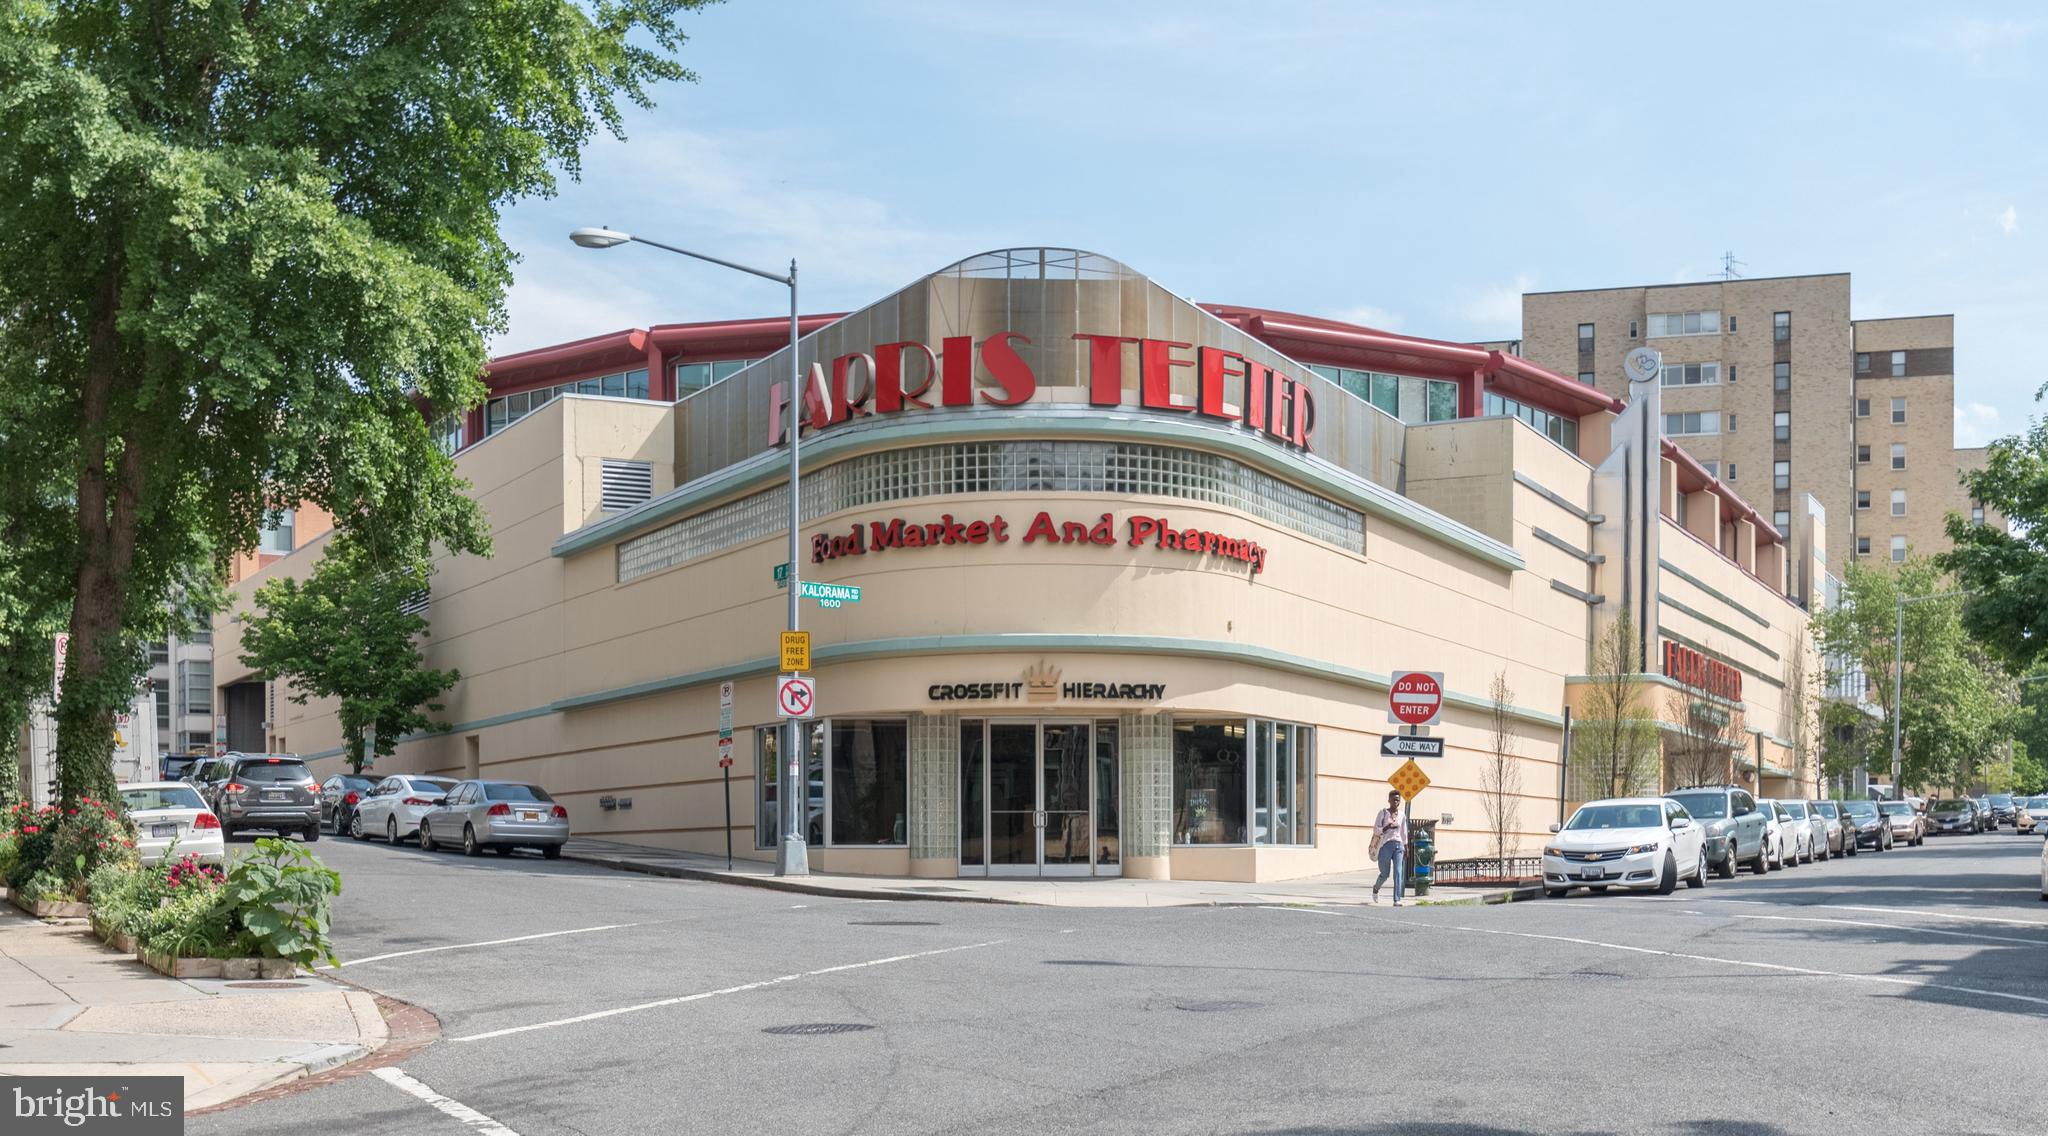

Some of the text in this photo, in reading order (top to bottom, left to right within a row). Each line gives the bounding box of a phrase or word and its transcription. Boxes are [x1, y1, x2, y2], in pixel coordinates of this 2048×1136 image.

[768, 331, 1316, 453] HARRIS TEETER
[811, 511, 1268, 575] Food Market And Pharmacy
[801, 584, 851, 600] KALORAMA
[820, 599, 841, 608] 1600
[785, 636, 805, 644] DRUG
[786, 647, 805, 655] FREE
[786, 658, 804, 666] ZONE
[928, 682, 1166, 700] CROSSFIT HIERARCHY
[1398, 682, 1435, 692] DO NOT
[1399, 705, 1430, 715] ENTER
[1399, 741, 1437, 751] ONE WAY
